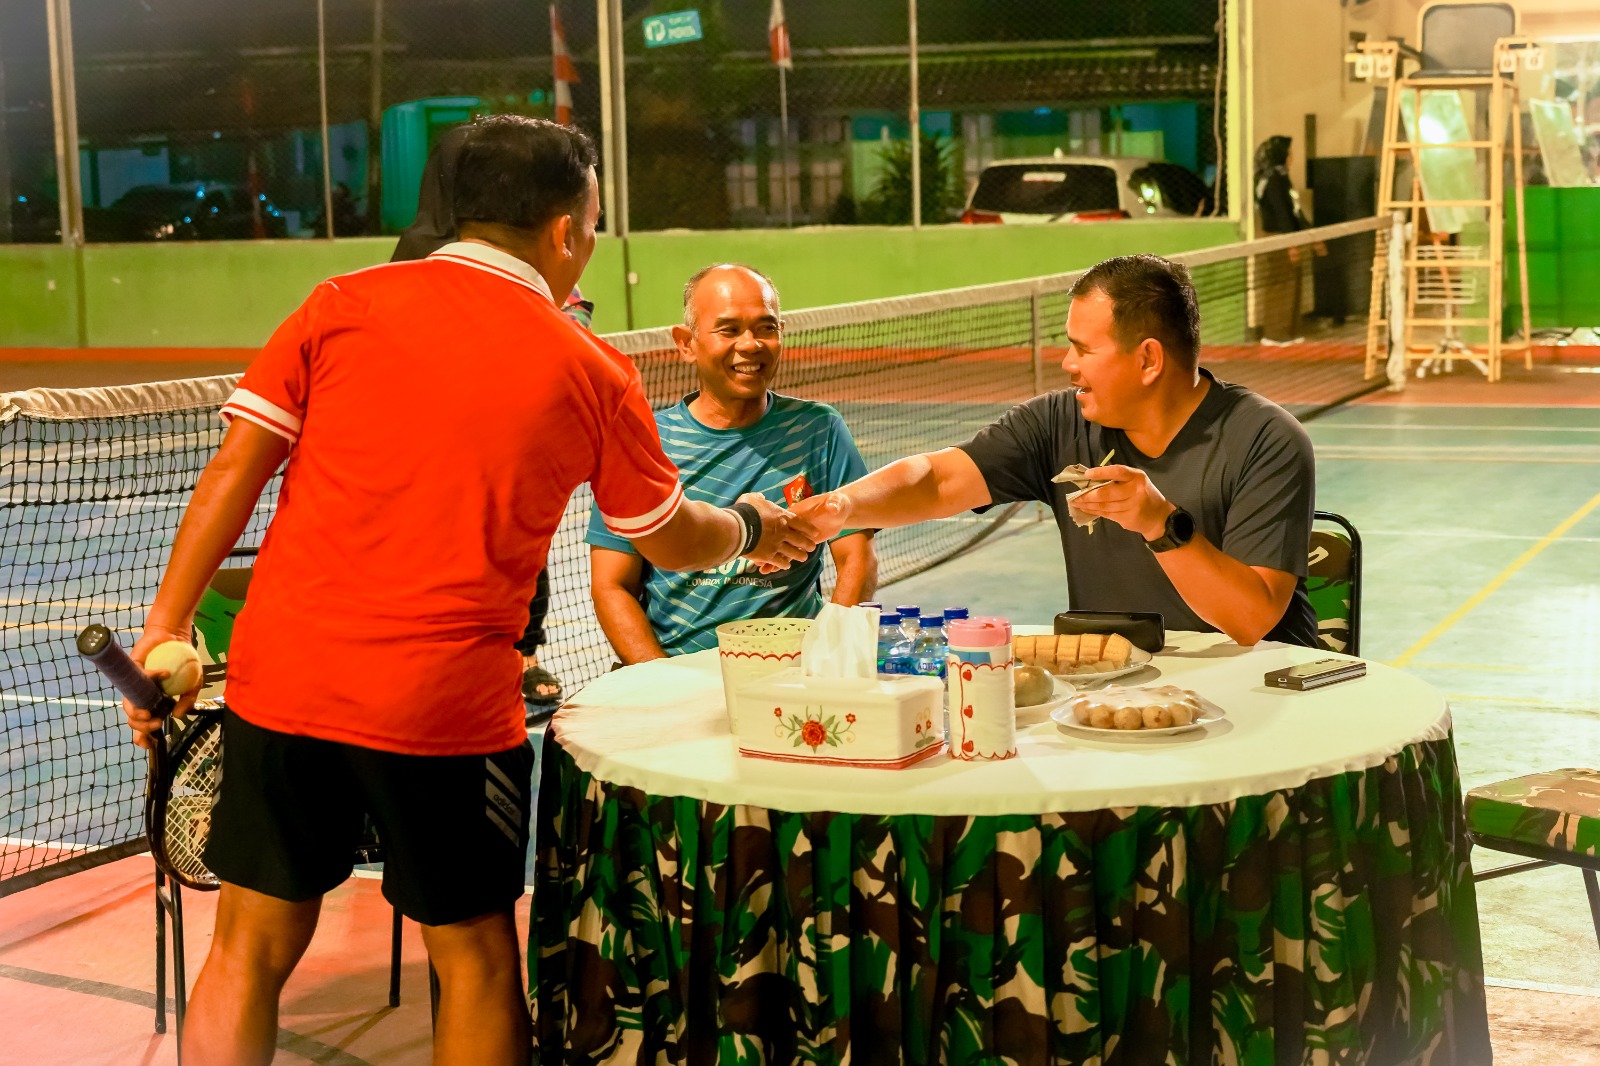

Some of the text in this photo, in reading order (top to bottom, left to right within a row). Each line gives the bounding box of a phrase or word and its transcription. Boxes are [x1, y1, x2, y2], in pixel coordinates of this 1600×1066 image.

[686, 576, 773, 588] LOMBOK INDONESIA
[917, 661, 939, 671] AQUA
